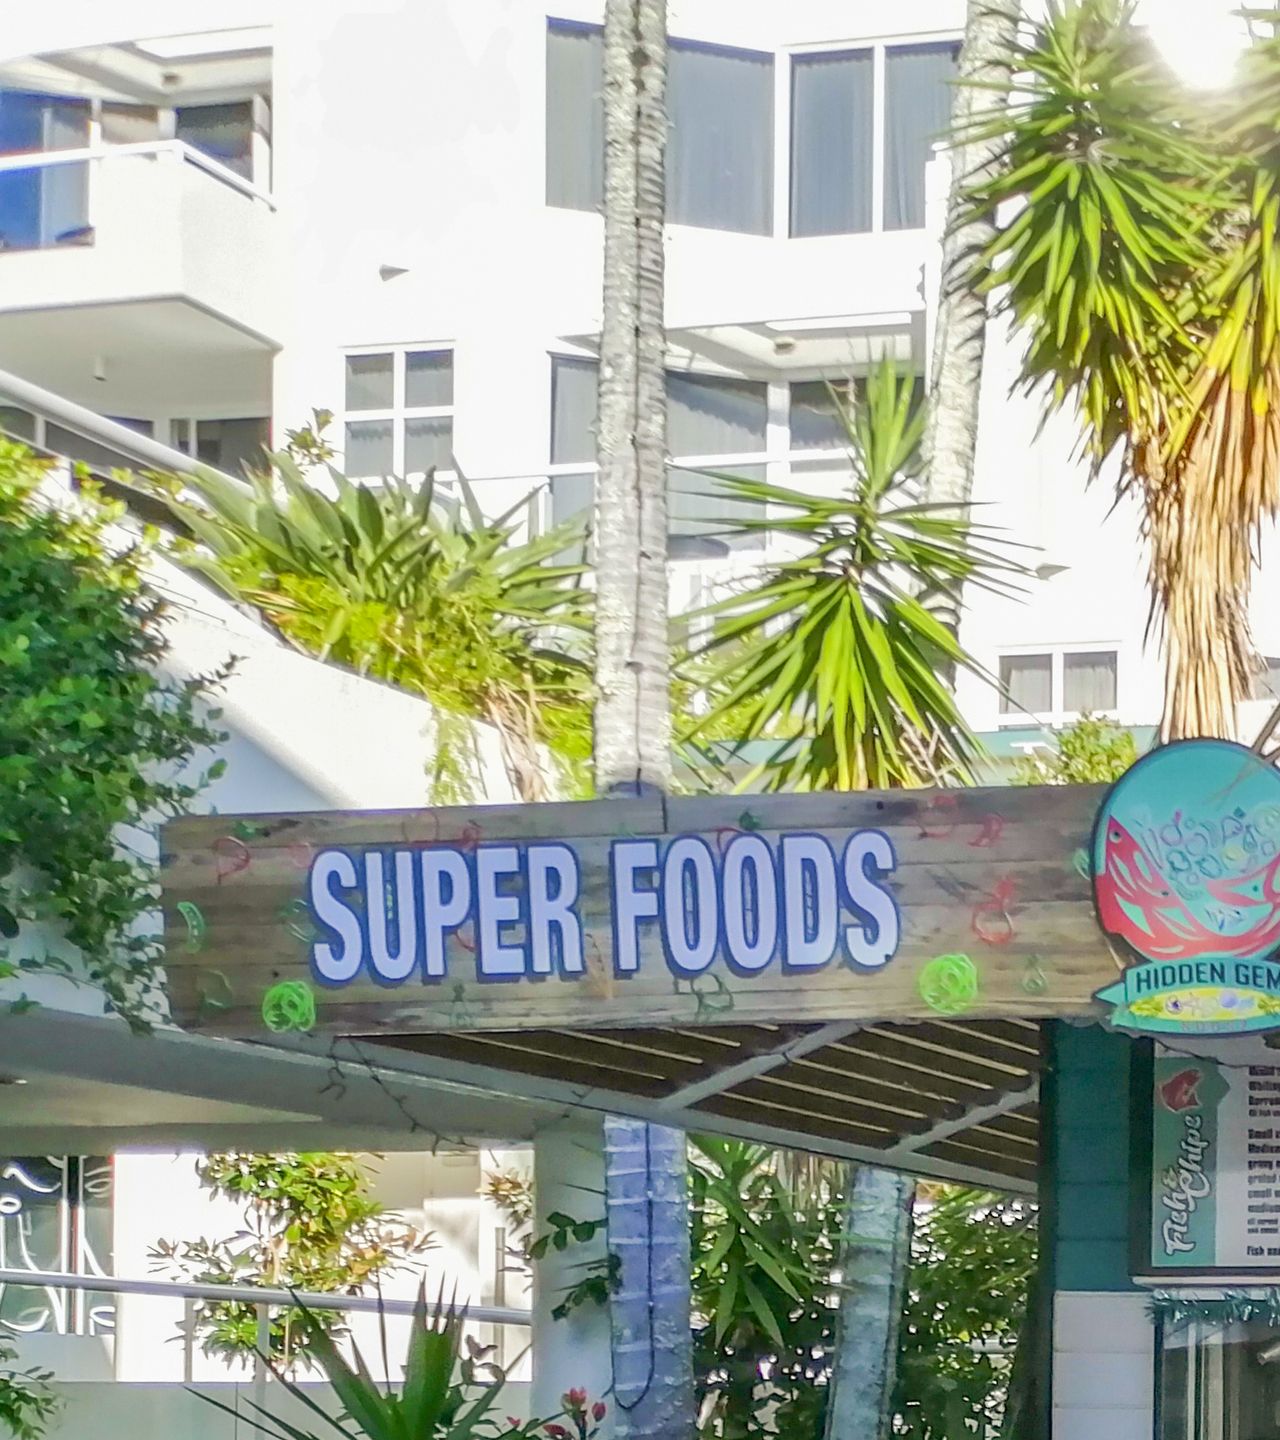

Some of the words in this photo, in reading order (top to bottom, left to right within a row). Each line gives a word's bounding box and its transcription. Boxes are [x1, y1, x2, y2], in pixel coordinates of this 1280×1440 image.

[308, 840, 584, 986] SUPER
[609, 830, 902, 976] FOODS
[1136, 962, 1225, 993] HIDDEN
[1246, 1245, 1265, 1256] Fish
